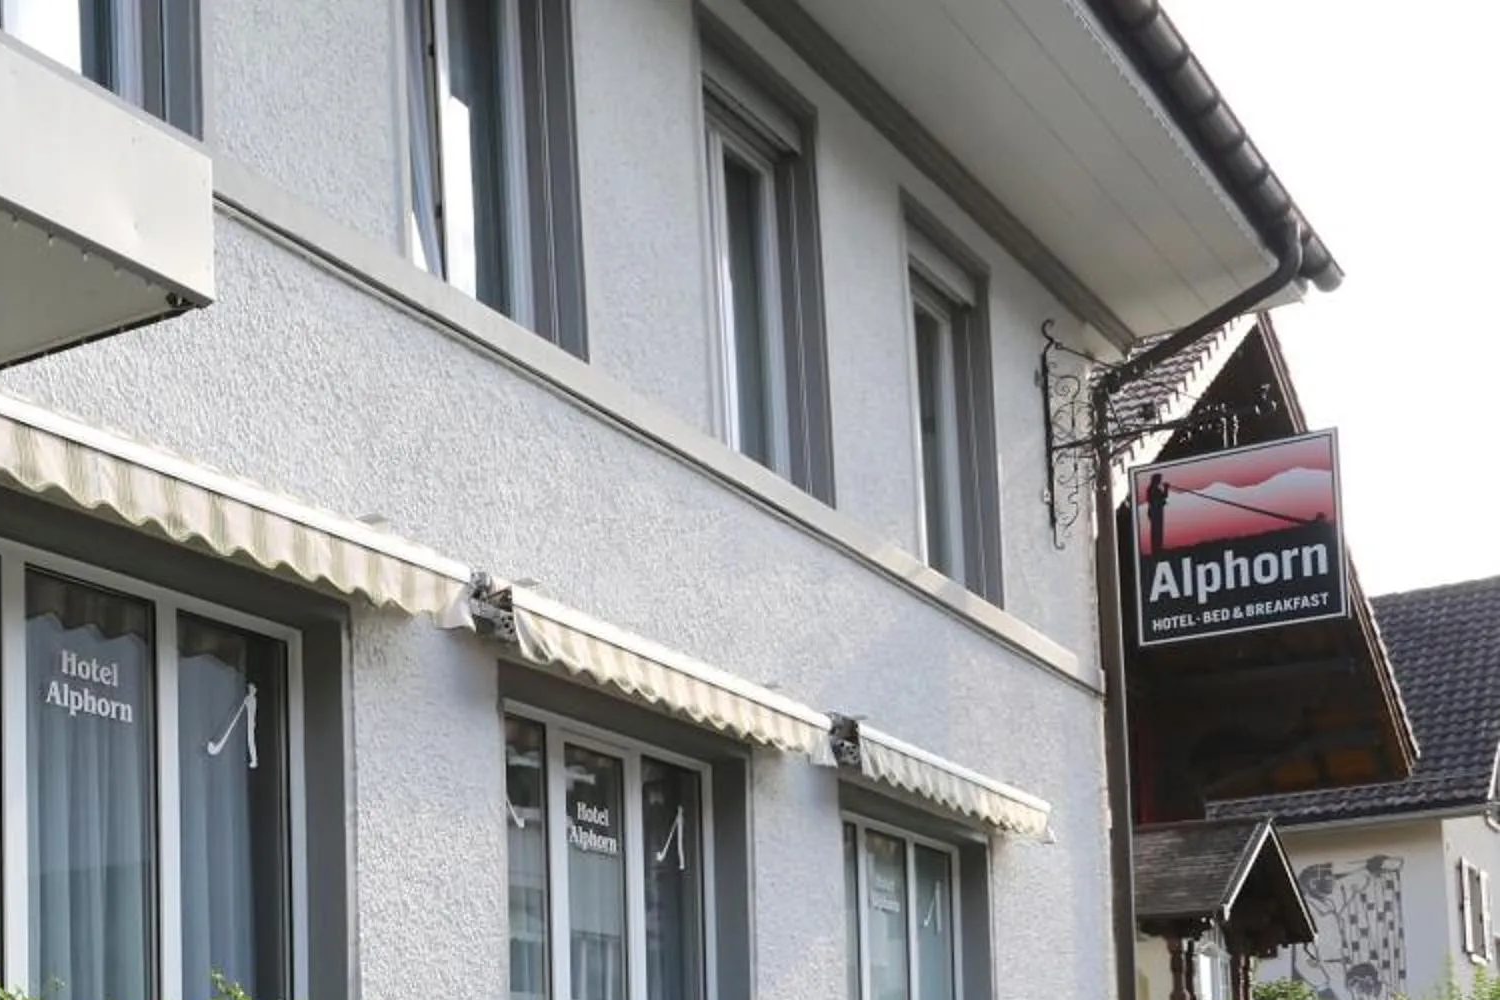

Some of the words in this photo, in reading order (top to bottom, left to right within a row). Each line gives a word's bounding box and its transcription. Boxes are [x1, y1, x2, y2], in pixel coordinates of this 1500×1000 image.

[1150, 543, 1328, 604] Alphorn
[1152, 614, 1196, 632] HOTEL
[1203, 607, 1230, 624] BED
[1232, 605, 1244, 619] &
[1246, 592, 1329, 616] BREAKFAST
[62, 649, 119, 687] Hotel
[45, 681, 133, 723] Alphorn
[577, 801, 609, 826] Hotel
[569, 825, 617, 853] Alphorn
